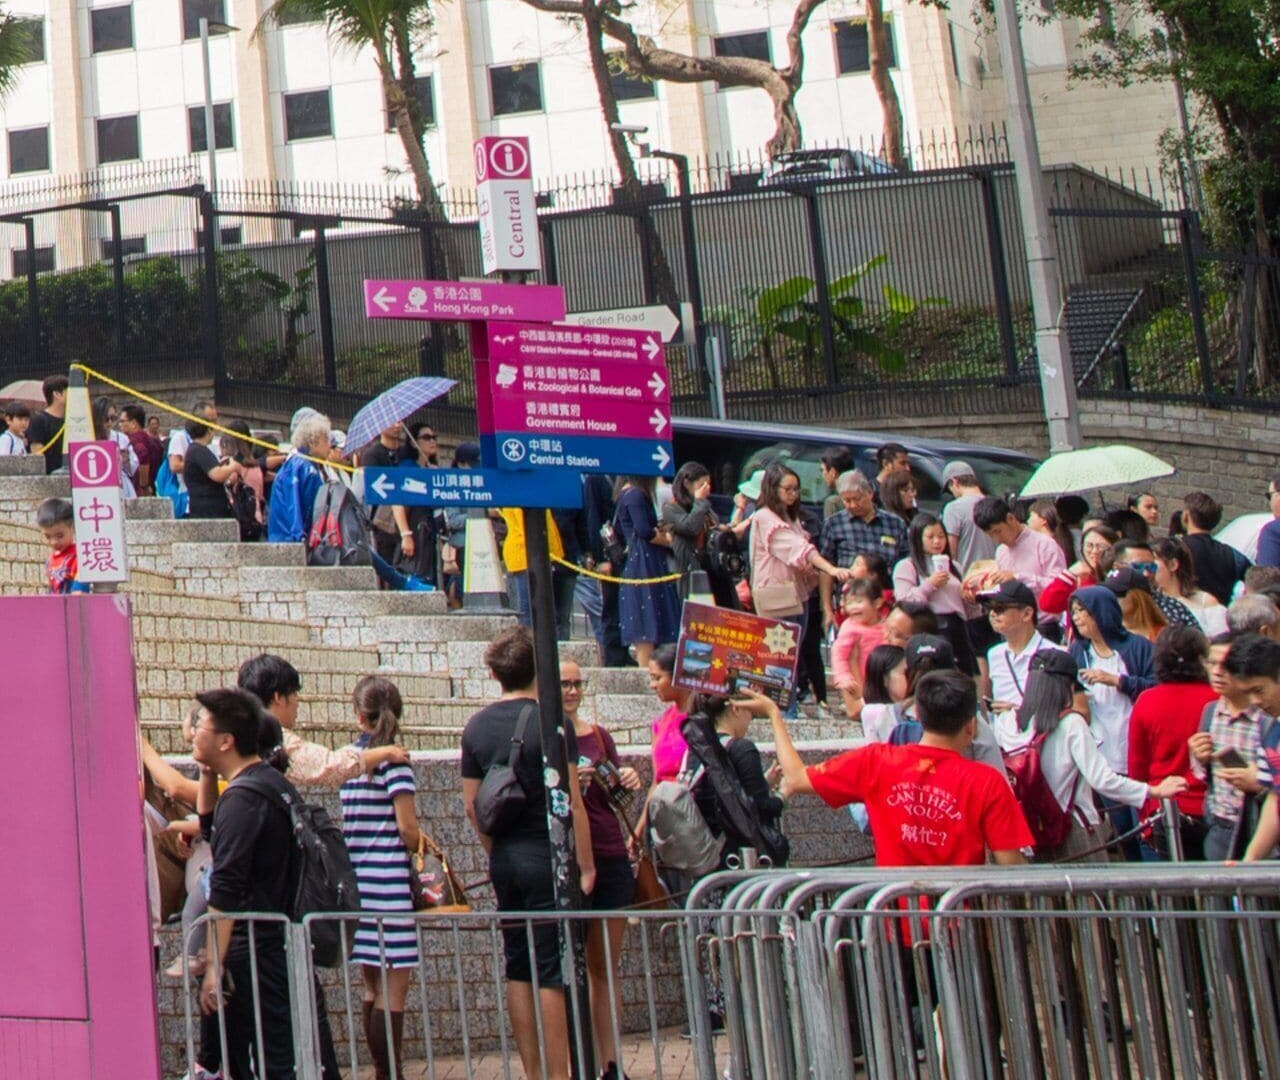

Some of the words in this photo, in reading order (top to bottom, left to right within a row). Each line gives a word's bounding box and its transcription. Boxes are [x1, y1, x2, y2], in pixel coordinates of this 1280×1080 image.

[503, 189, 525, 259] Central
[433, 286, 482, 301] 香港公園
[433, 302, 460, 315] Hong
[462, 303, 489, 316] Kong
[491, 304, 514, 315] Park
[577, 315, 613, 326] Garden
[616, 312, 646, 323] Road
[523, 381, 536, 391] HK
[537, 382, 580, 395] Zoological
[581, 384, 586, 393] &
[589, 385, 624, 396] Botanical
[525, 417, 585, 431] Government
[588, 420, 617, 432] House
[528, 438, 562, 453] 中環站
[529, 453, 565, 466] Central
[567, 455, 600, 467] Station
[432, 474, 484, 488] 山頂纜車
[432, 489, 460, 500] Peak
[464, 490, 493, 501] Tram
[78, 496, 119, 572] 中環
[886, 791, 915, 807] CAN
[927, 793, 963, 820] HELP
[904, 804, 945, 822] YOU?
